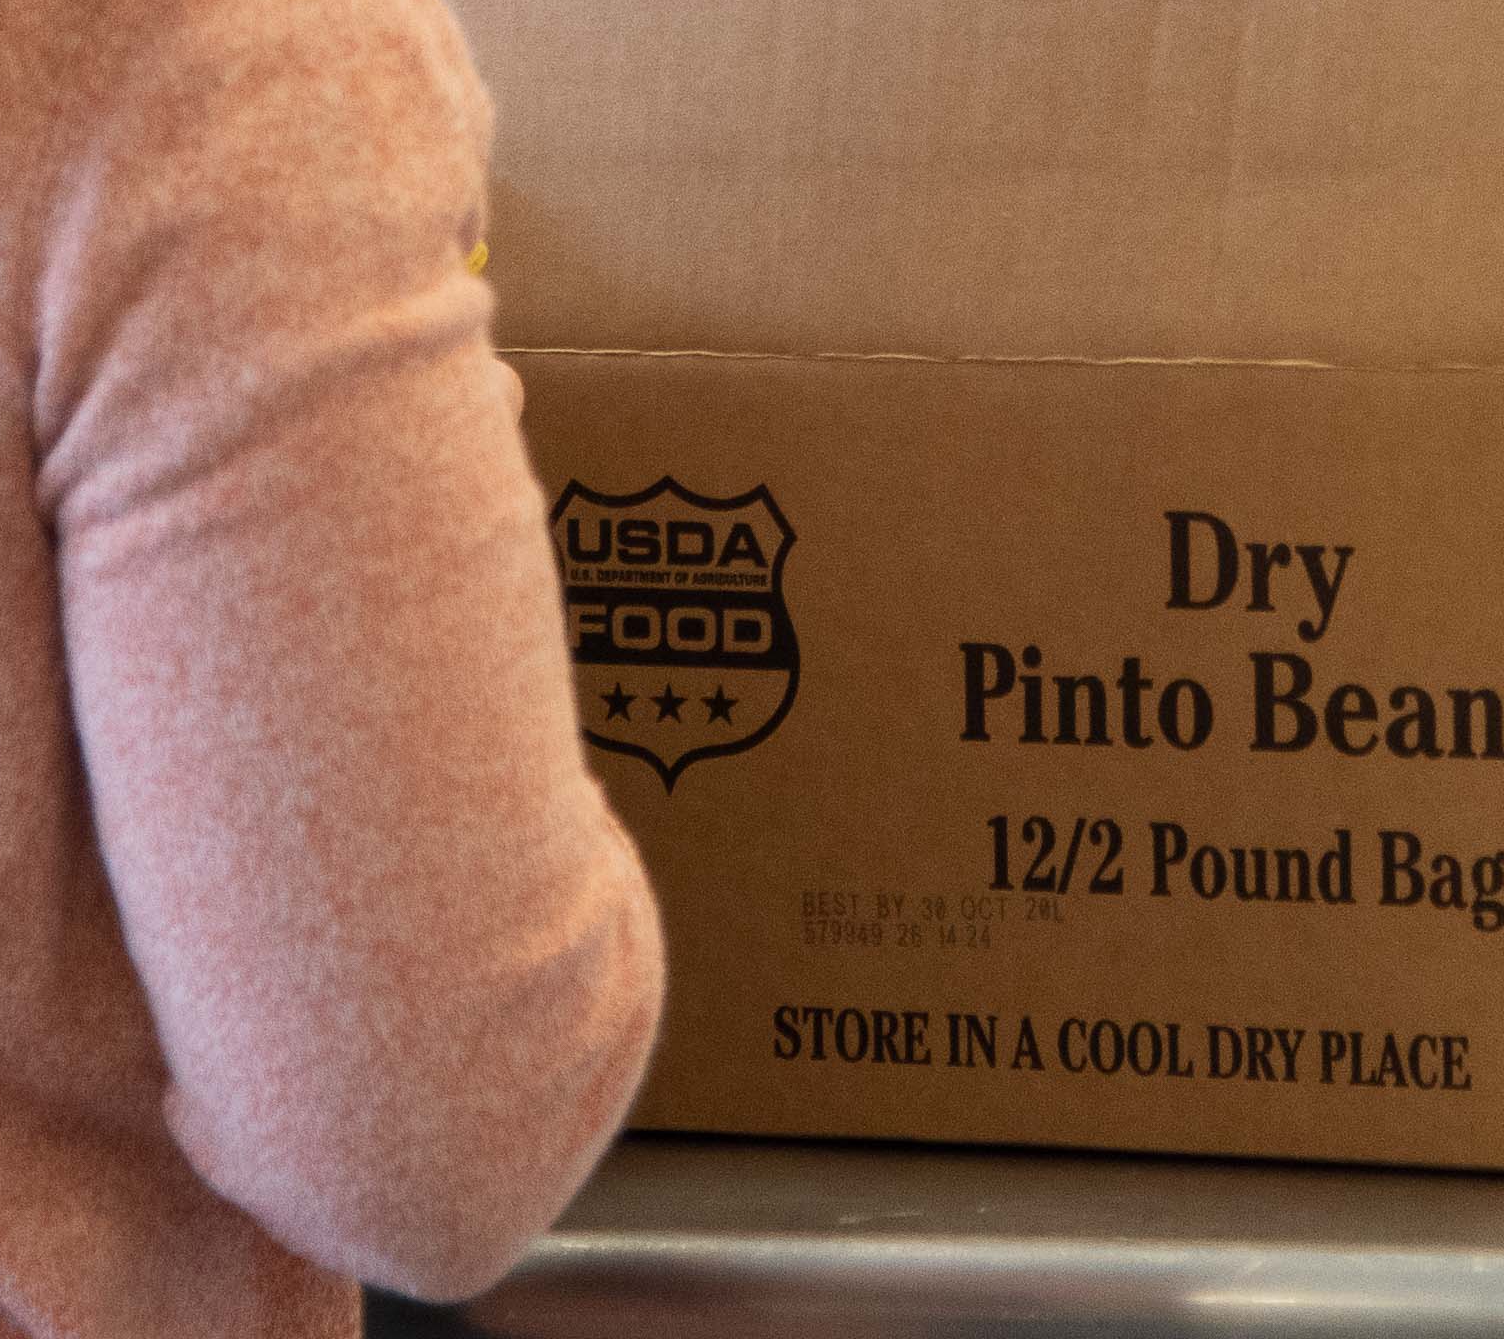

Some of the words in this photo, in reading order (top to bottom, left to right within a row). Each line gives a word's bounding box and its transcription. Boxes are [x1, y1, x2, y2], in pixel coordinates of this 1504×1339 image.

[567, 519, 768, 568] USDA
[1163, 510, 1354, 643] Dry
[571, 604, 773, 654] FOOD
[959, 642, 1213, 751] Pinto
[987, 815, 1123, 894] 12/2
[1149, 822, 1356, 904] Pound
[876, 893, 905, 921] BY
[773, 1005, 930, 1064] STORE
[947, 1014, 997, 1068] IN
[1011, 1016, 1044, 1070] A
[1057, 1017, 1193, 1077] COOL
[1206, 1025, 1305, 1081] DRY
[1319, 1030, 1471, 1090] PLACE
